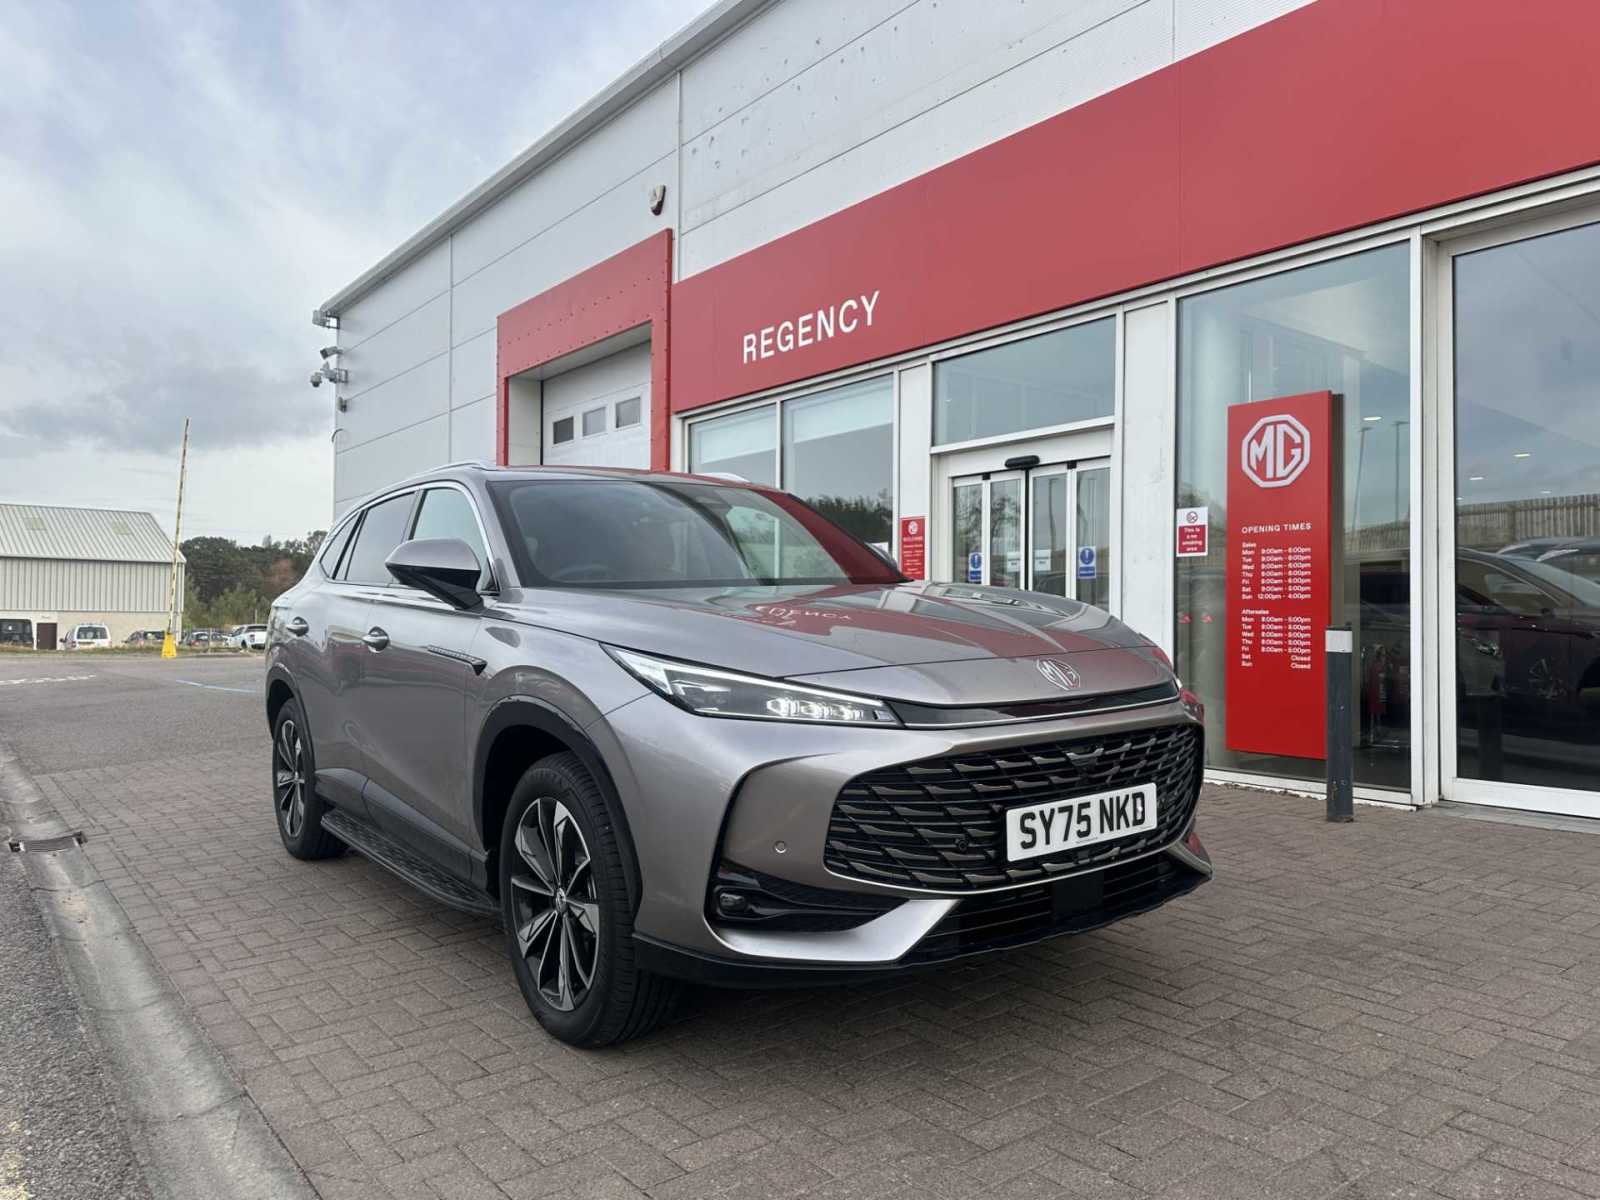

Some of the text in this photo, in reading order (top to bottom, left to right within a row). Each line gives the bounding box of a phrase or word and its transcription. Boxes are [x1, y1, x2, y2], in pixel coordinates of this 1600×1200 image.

[743, 290, 880, 364] REGENCY
[1249, 422, 1302, 479] MG
[1241, 522, 1312, 534] OPENING TIMES
[1020, 791, 1146, 849] SY75 NKD
